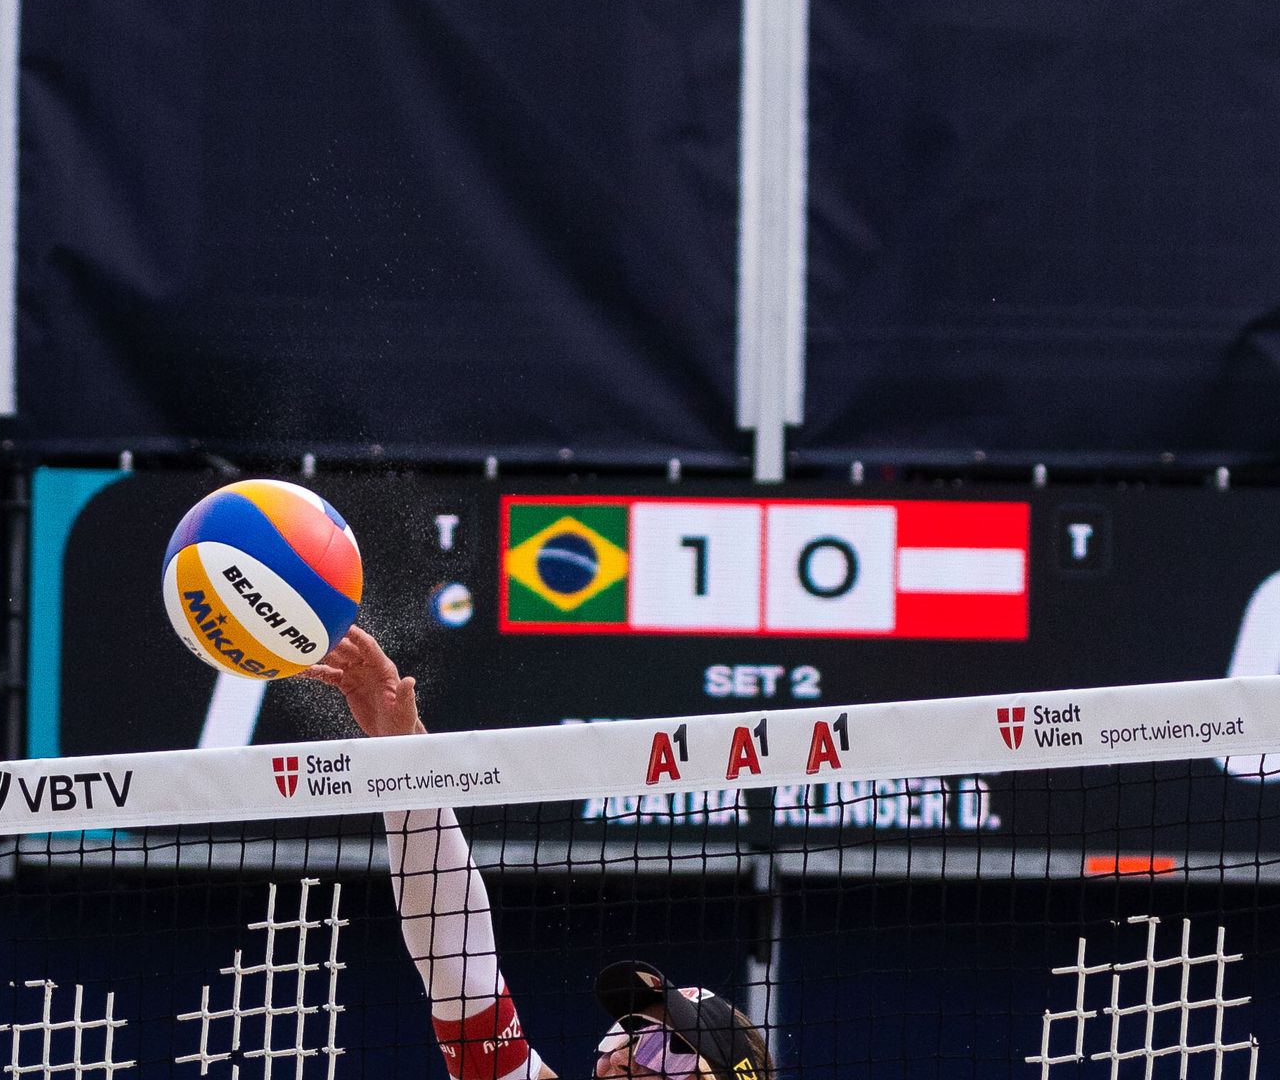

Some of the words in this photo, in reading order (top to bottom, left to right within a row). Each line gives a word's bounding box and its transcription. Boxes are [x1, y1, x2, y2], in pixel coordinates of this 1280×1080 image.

[1068, 524, 1093, 558] T
[680, 536, 710, 596] 1
[796, 536, 858, 599] 0
[222, 565, 287, 629] BEACH
[279, 625, 318, 655] PRO
[705, 665, 785, 697] SET
[791, 665, 822, 697] 2
[1034, 703, 1081, 725] Stadt
[646, 724, 688, 785] A1
[726, 718, 768, 780] A1
[806, 713, 849, 774] A1
[1035, 728, 1082, 748] Wien
[1100, 717, 1244, 749] sport.wien.gv.at
[307, 754, 351, 774] Stadt
[18, 771, 133, 813] VBTV
[307, 777, 352, 796] Wien
[367, 768, 501, 797] sport.wien.gv.at
[772, 777, 951, 830] KLINGER
